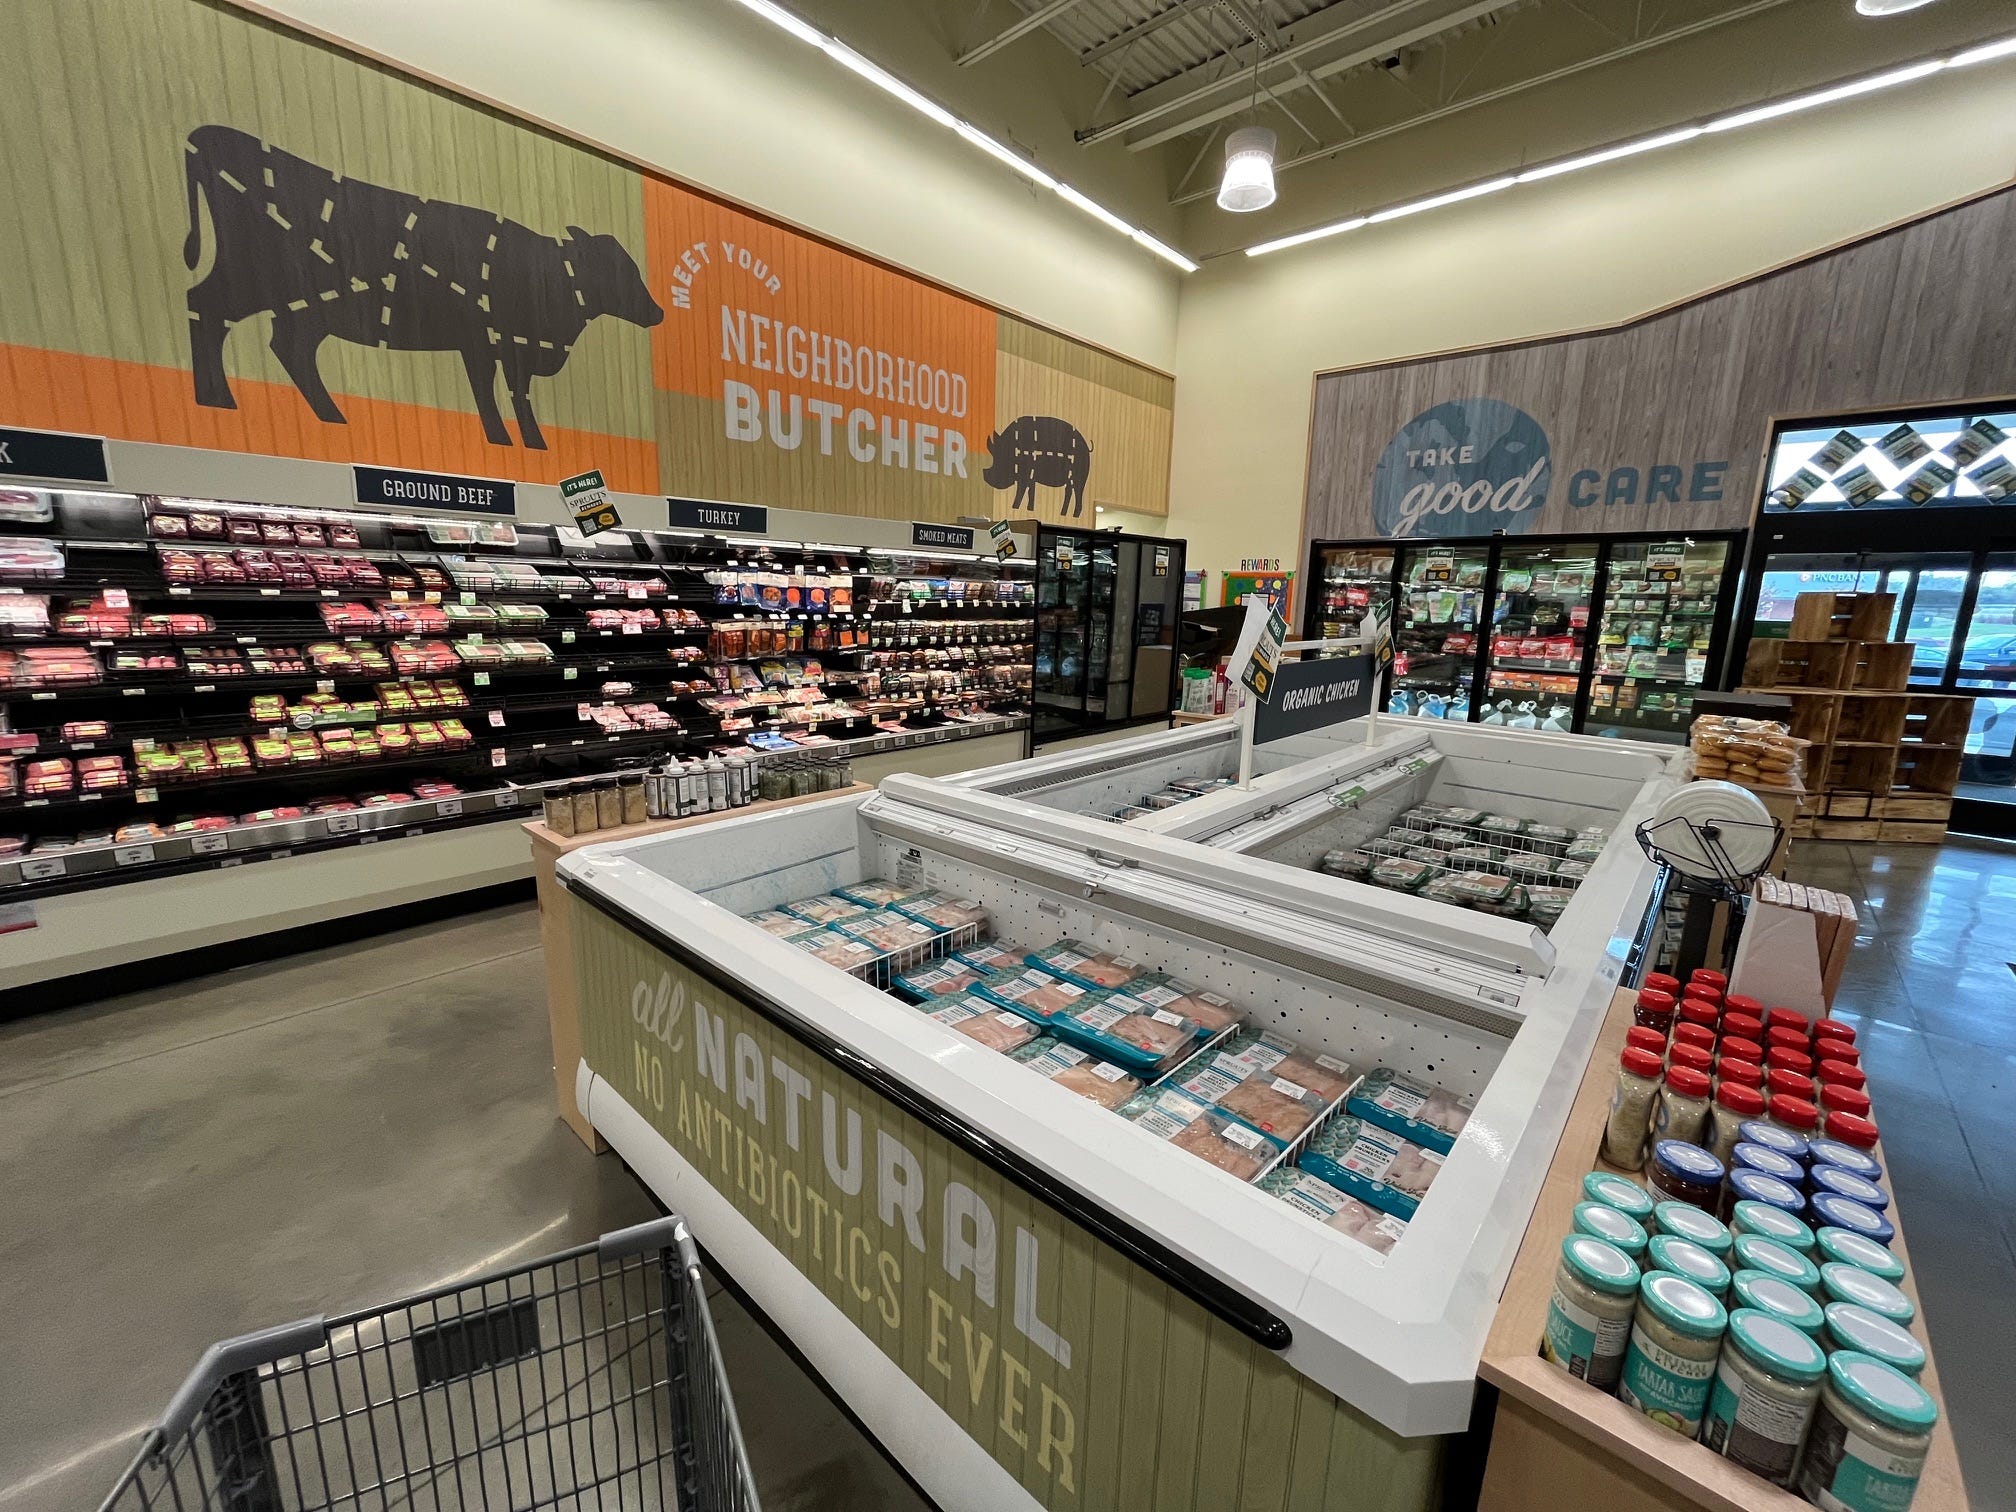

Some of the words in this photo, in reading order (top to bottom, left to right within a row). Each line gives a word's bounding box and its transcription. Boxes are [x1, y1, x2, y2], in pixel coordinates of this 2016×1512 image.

[671, 241, 710, 309] MEET
[722, 241, 781, 295] YOUR
[721, 305, 967, 418] NEIGHBORHOOD
[724, 379, 967, 479] BUTCHER
[1406, 445, 1474, 467] TAKE
[382, 479, 451, 502] GROUND
[458, 486, 494, 506] BEEF
[569, 491, 607, 508] SPROUTS
[1392, 456, 1545, 538] good
[1568, 461, 1728, 508] CARE
[698, 509, 740, 525] TURKEY
[919, 529, 945, 542] SMOKED
[947, 532, 967, 544] MEATS
[1241, 559, 1280, 571] REWARDS
[1282, 684, 1324, 712] ORGANIC
[1325, 679, 1360, 702] CHICKEN
[1361, 1143, 1388, 1158] CHICKEN
[632, 971, 684, 1052] all
[695, 1001, 1070, 1370] NATURAL
[1290, 1197, 1320, 1216] CHICKEN
[634, 1039, 665, 1112] NO
[676, 1080, 900, 1329] ANTIBIOTICS
[927, 1288, 1076, 1495] EVER
